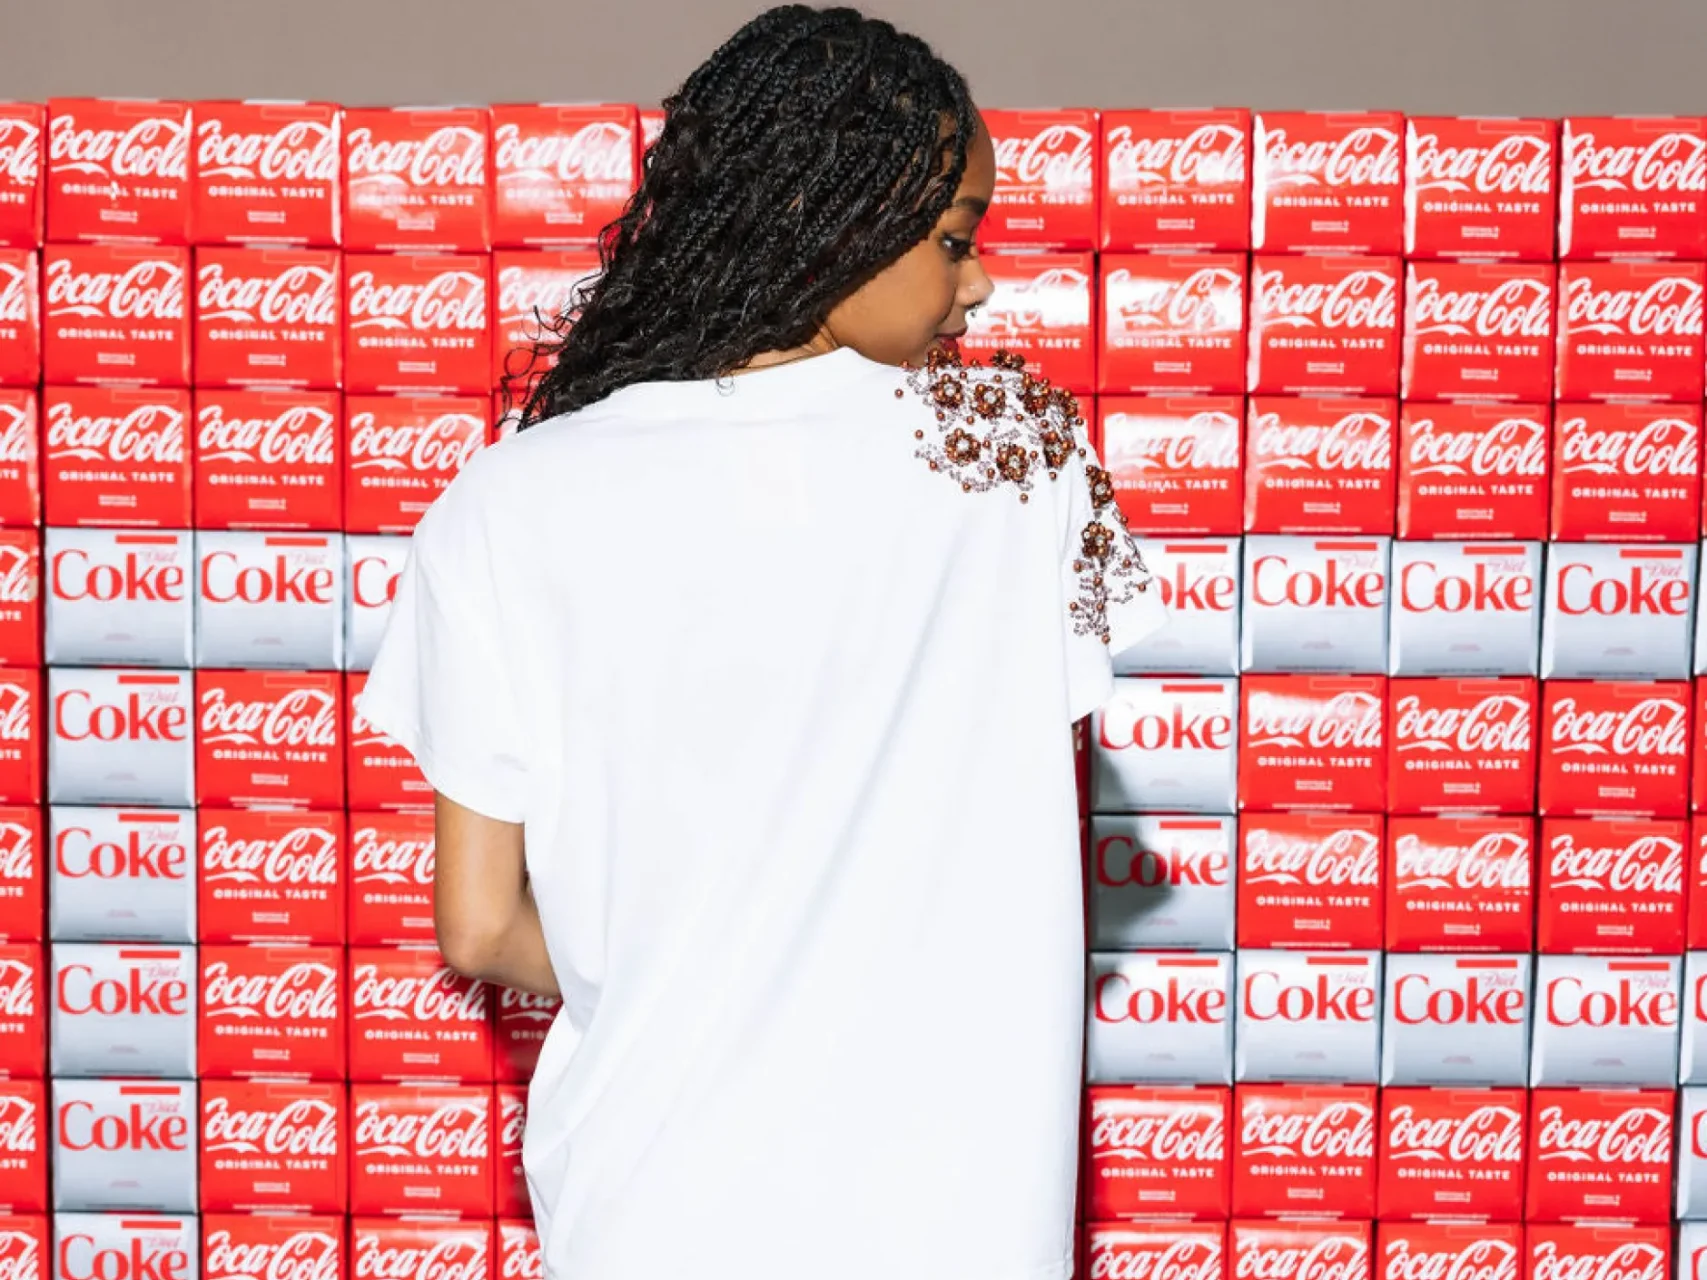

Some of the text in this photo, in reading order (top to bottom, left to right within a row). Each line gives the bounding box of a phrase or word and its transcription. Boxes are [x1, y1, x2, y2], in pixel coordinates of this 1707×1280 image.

[209, 185, 324, 198] ORIGINAL TASTE
[1424, 201, 1539, 213] ORIGINAL TASTE
[1581, 203, 1696, 214] ORIGINAL TASTE
[58, 328, 173, 339] ORIGINAL TASTE
[209, 328, 324, 341] ORIGINAL TASTE
[359, 337, 474, 348] ORIGINAL TASTE
[1423, 343, 1538, 356] ORIGINAL TASTE
[1577, 344, 1692, 355] ORIGINAL TASTE
[59, 470, 174, 482] ORIGINAL TASTE
[209, 473, 324, 486] ORIGINAL TASTE
[1418, 485, 1533, 496] ORIGINAL TASTE
[1572, 487, 1687, 498] ORIGINAL TASTE
[52, 549, 183, 601] Coke
[202, 551, 332, 603] Coke
[1252, 555, 1383, 607] Coke
[1402, 560, 1532, 612] Coke
[1558, 563, 1688, 615] Coke
[56, 689, 186, 741] Coke
[1098, 701, 1229, 750] Coke
[212, 750, 327, 761] ORIGINAL TASTE
[1405, 759, 1520, 770] ORIGINAL TASTE
[1561, 762, 1676, 774] ORIGINAL TASTE
[56, 827, 186, 879] Coke
[1097, 836, 1229, 888] Coke
[213, 889, 328, 900] ORIGINAL TASTE
[1255, 895, 1370, 906] ORIGINAL TASTE
[1559, 902, 1674, 913] ORIGINAL TASTE
[56, 965, 187, 1014] Coke
[1094, 974, 1225, 1023] Coke
[1244, 972, 1374, 1021] Coke
[1395, 974, 1522, 1024] Coke
[1548, 976, 1675, 1026] Coke
[216, 1025, 326, 1036] ORIGINAL TASTE
[59, 1100, 186, 1150] Coke
[215, 1159, 326, 1170] ORIGINAL TASTE
[1399, 1168, 1509, 1179] ORIGINAL TASTE
[1548, 1171, 1658, 1182] ORIGINAL TASTE
